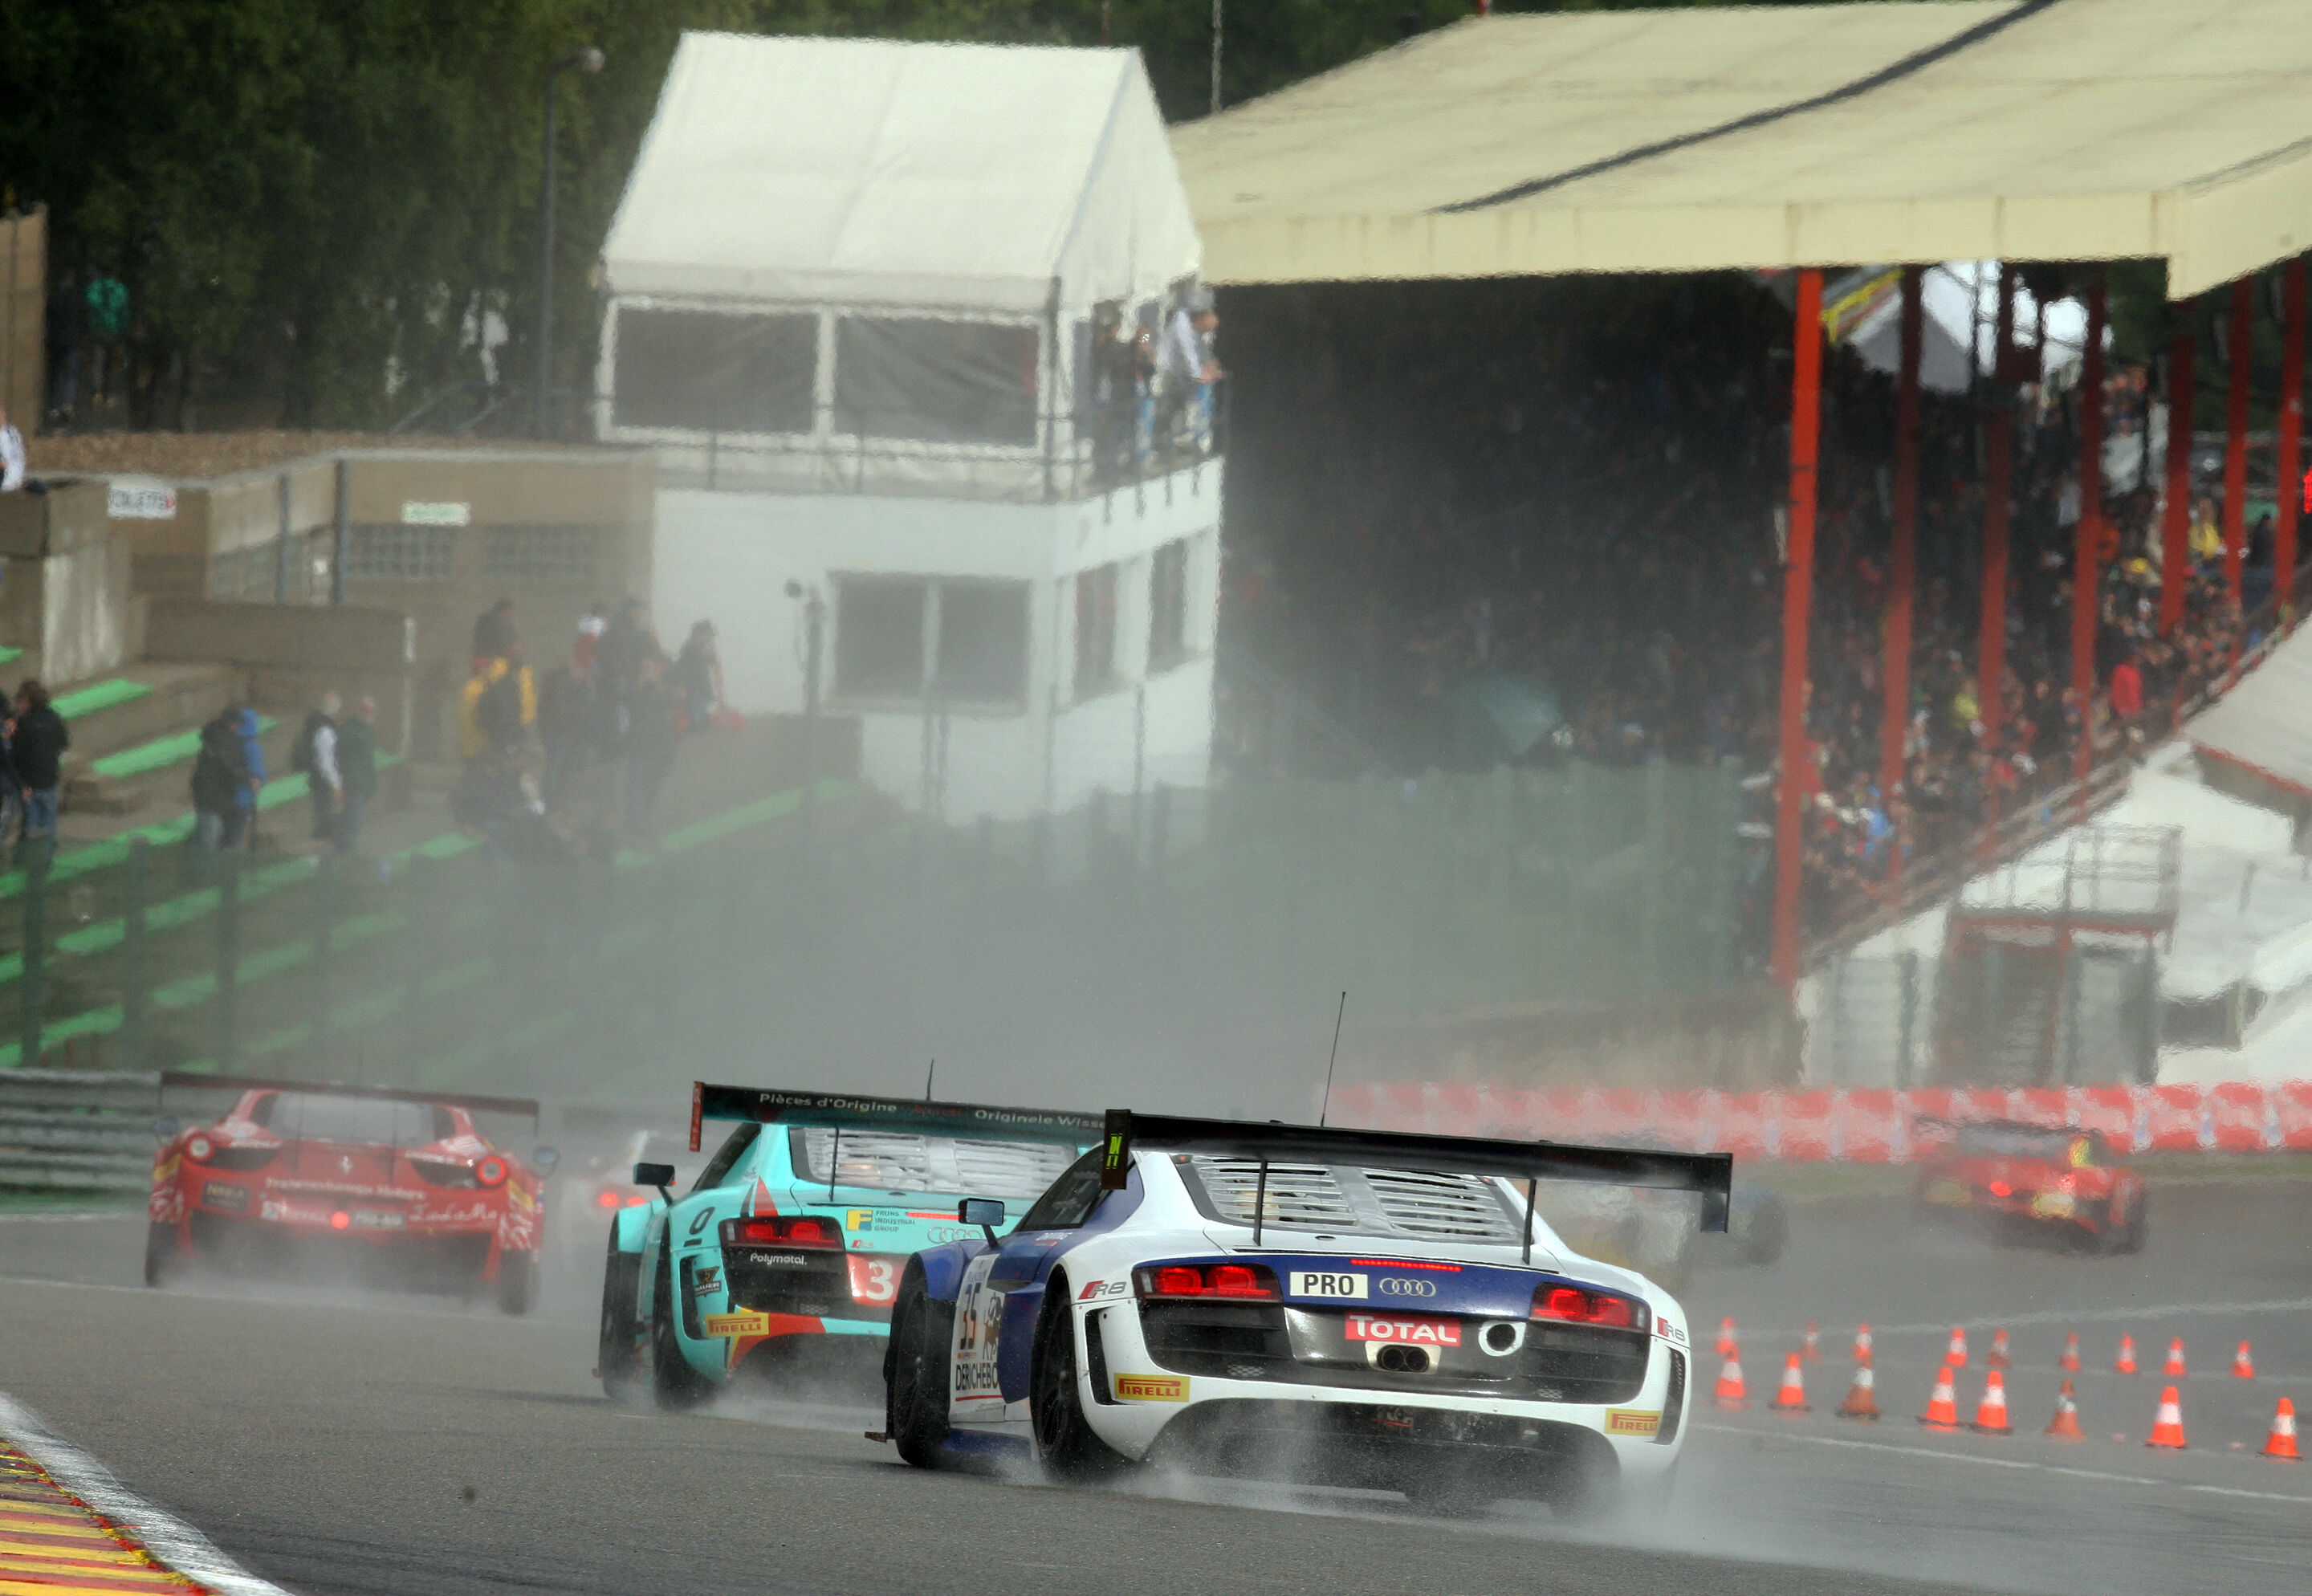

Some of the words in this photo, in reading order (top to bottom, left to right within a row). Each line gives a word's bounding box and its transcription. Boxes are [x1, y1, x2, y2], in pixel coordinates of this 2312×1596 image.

[759, 1093, 812, 1106] Pièces
[816, 1097, 898, 1113] d'Origine
[975, 1109, 1053, 1125] Originele
[865, 1259, 893, 1301] 3
[1082, 1280, 1126, 1299] R8
[1303, 1273, 1354, 1296] PRO
[708, 1317, 762, 1333] PIRELLI
[1349, 1314, 1458, 1343] TOTAL
[1660, 1319, 1686, 1342] R8
[1118, 1378, 1182, 1397] PIRELLI
